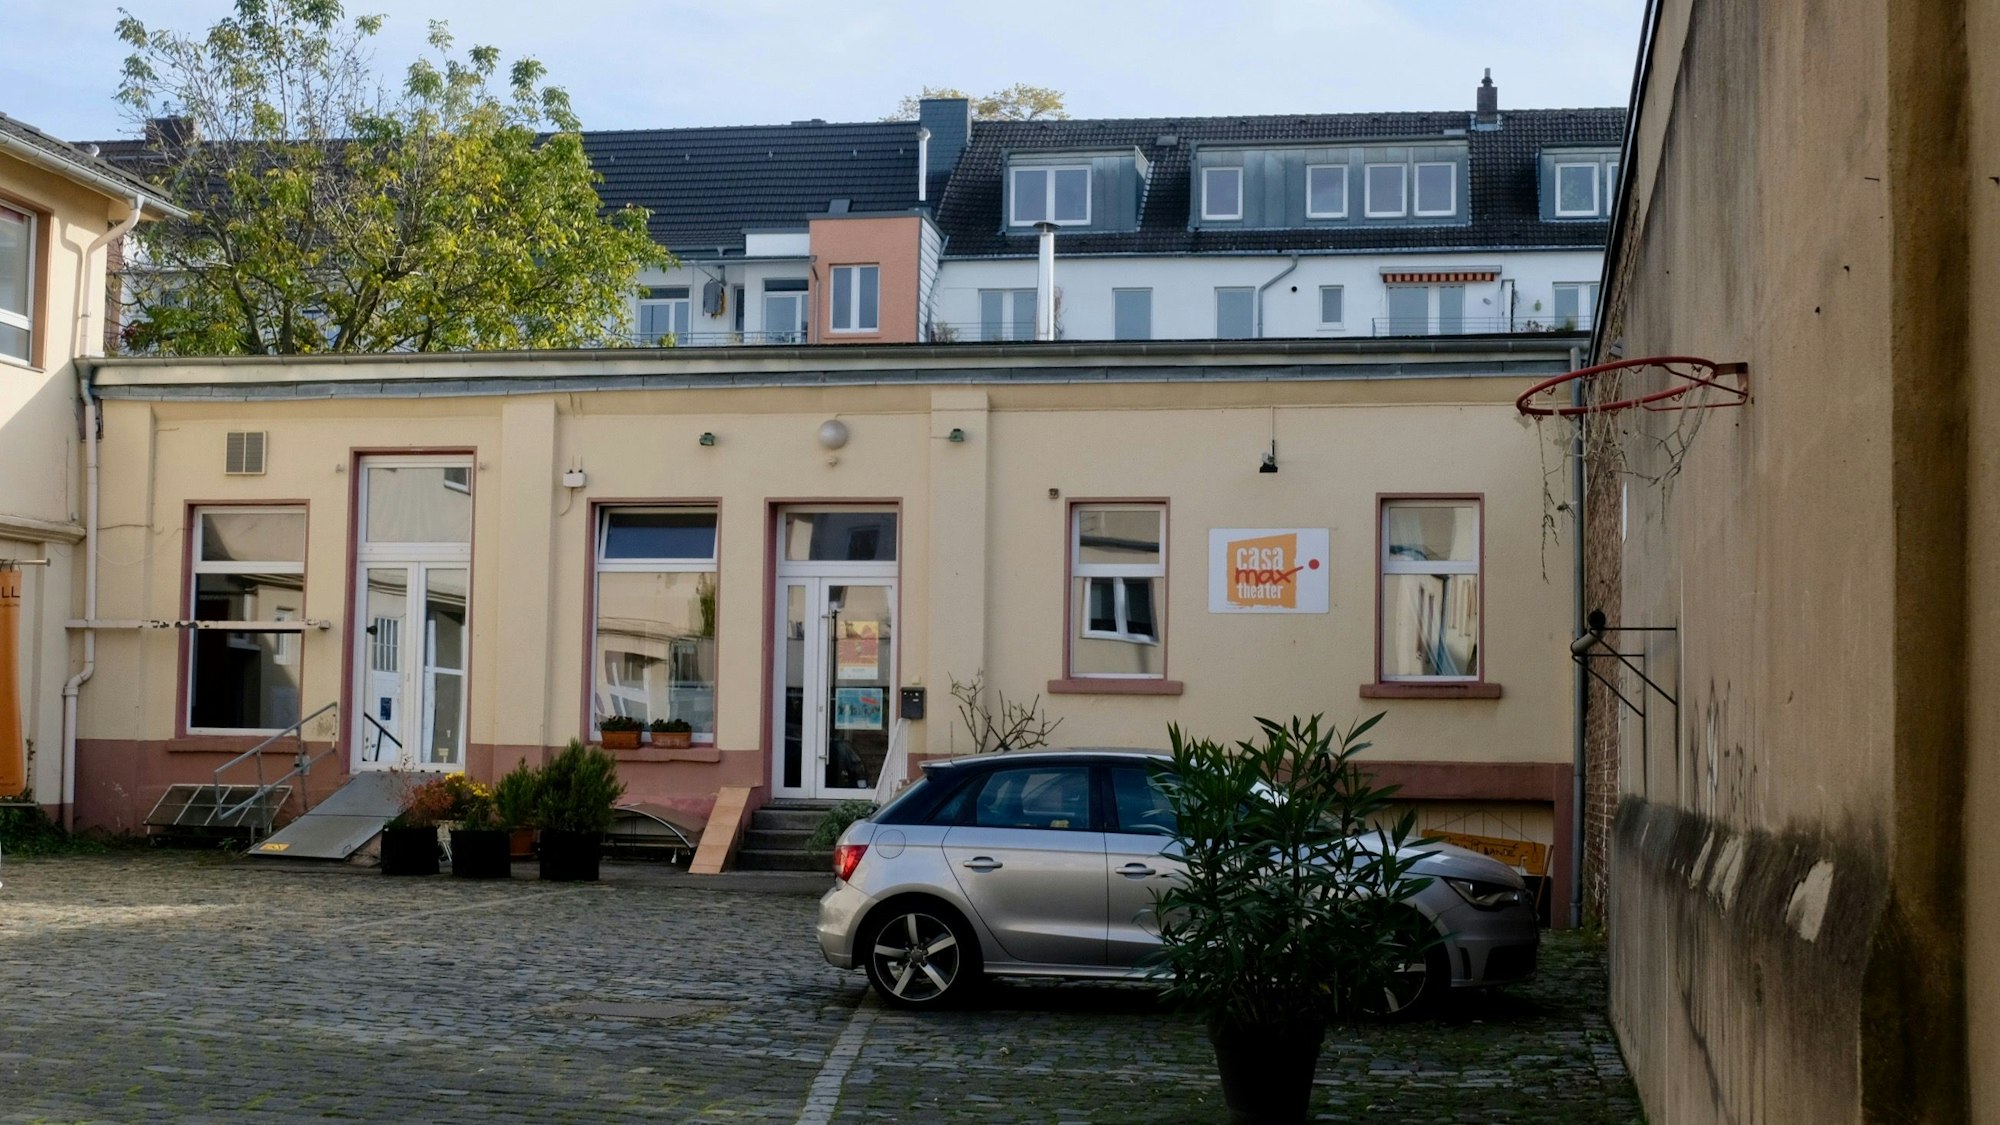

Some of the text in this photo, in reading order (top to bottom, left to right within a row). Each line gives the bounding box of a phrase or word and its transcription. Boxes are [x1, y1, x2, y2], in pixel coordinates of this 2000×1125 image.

[1236, 547, 1284, 570] casa
[1235, 567, 1304, 587] max
[1236, 583, 1284, 599] theater
